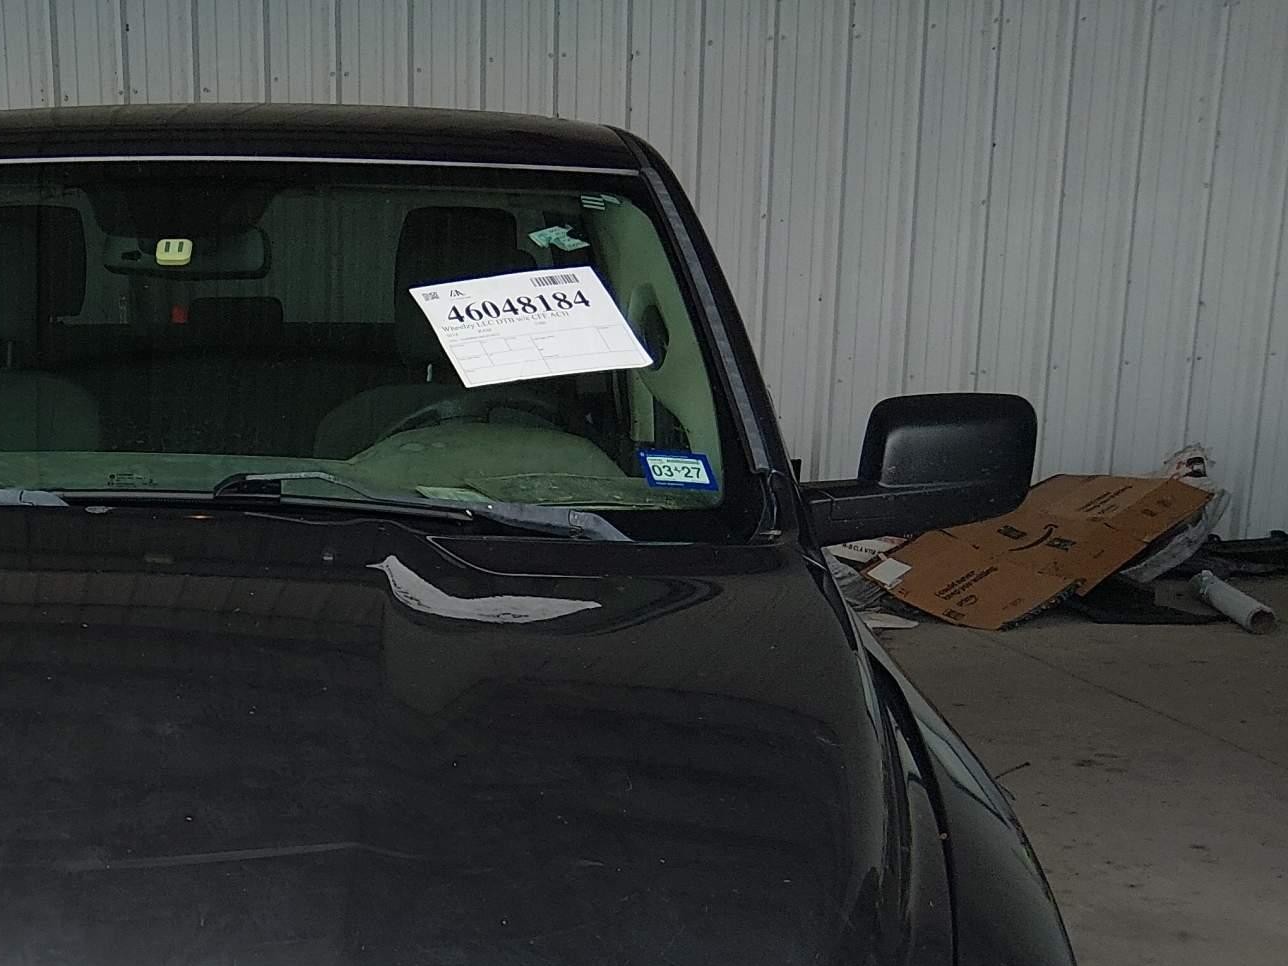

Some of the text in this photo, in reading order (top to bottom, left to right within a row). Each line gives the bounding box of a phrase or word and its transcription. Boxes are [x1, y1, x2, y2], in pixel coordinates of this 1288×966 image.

[447, 289, 592, 323] 46048184
[651, 464, 701, 479] 03 27
